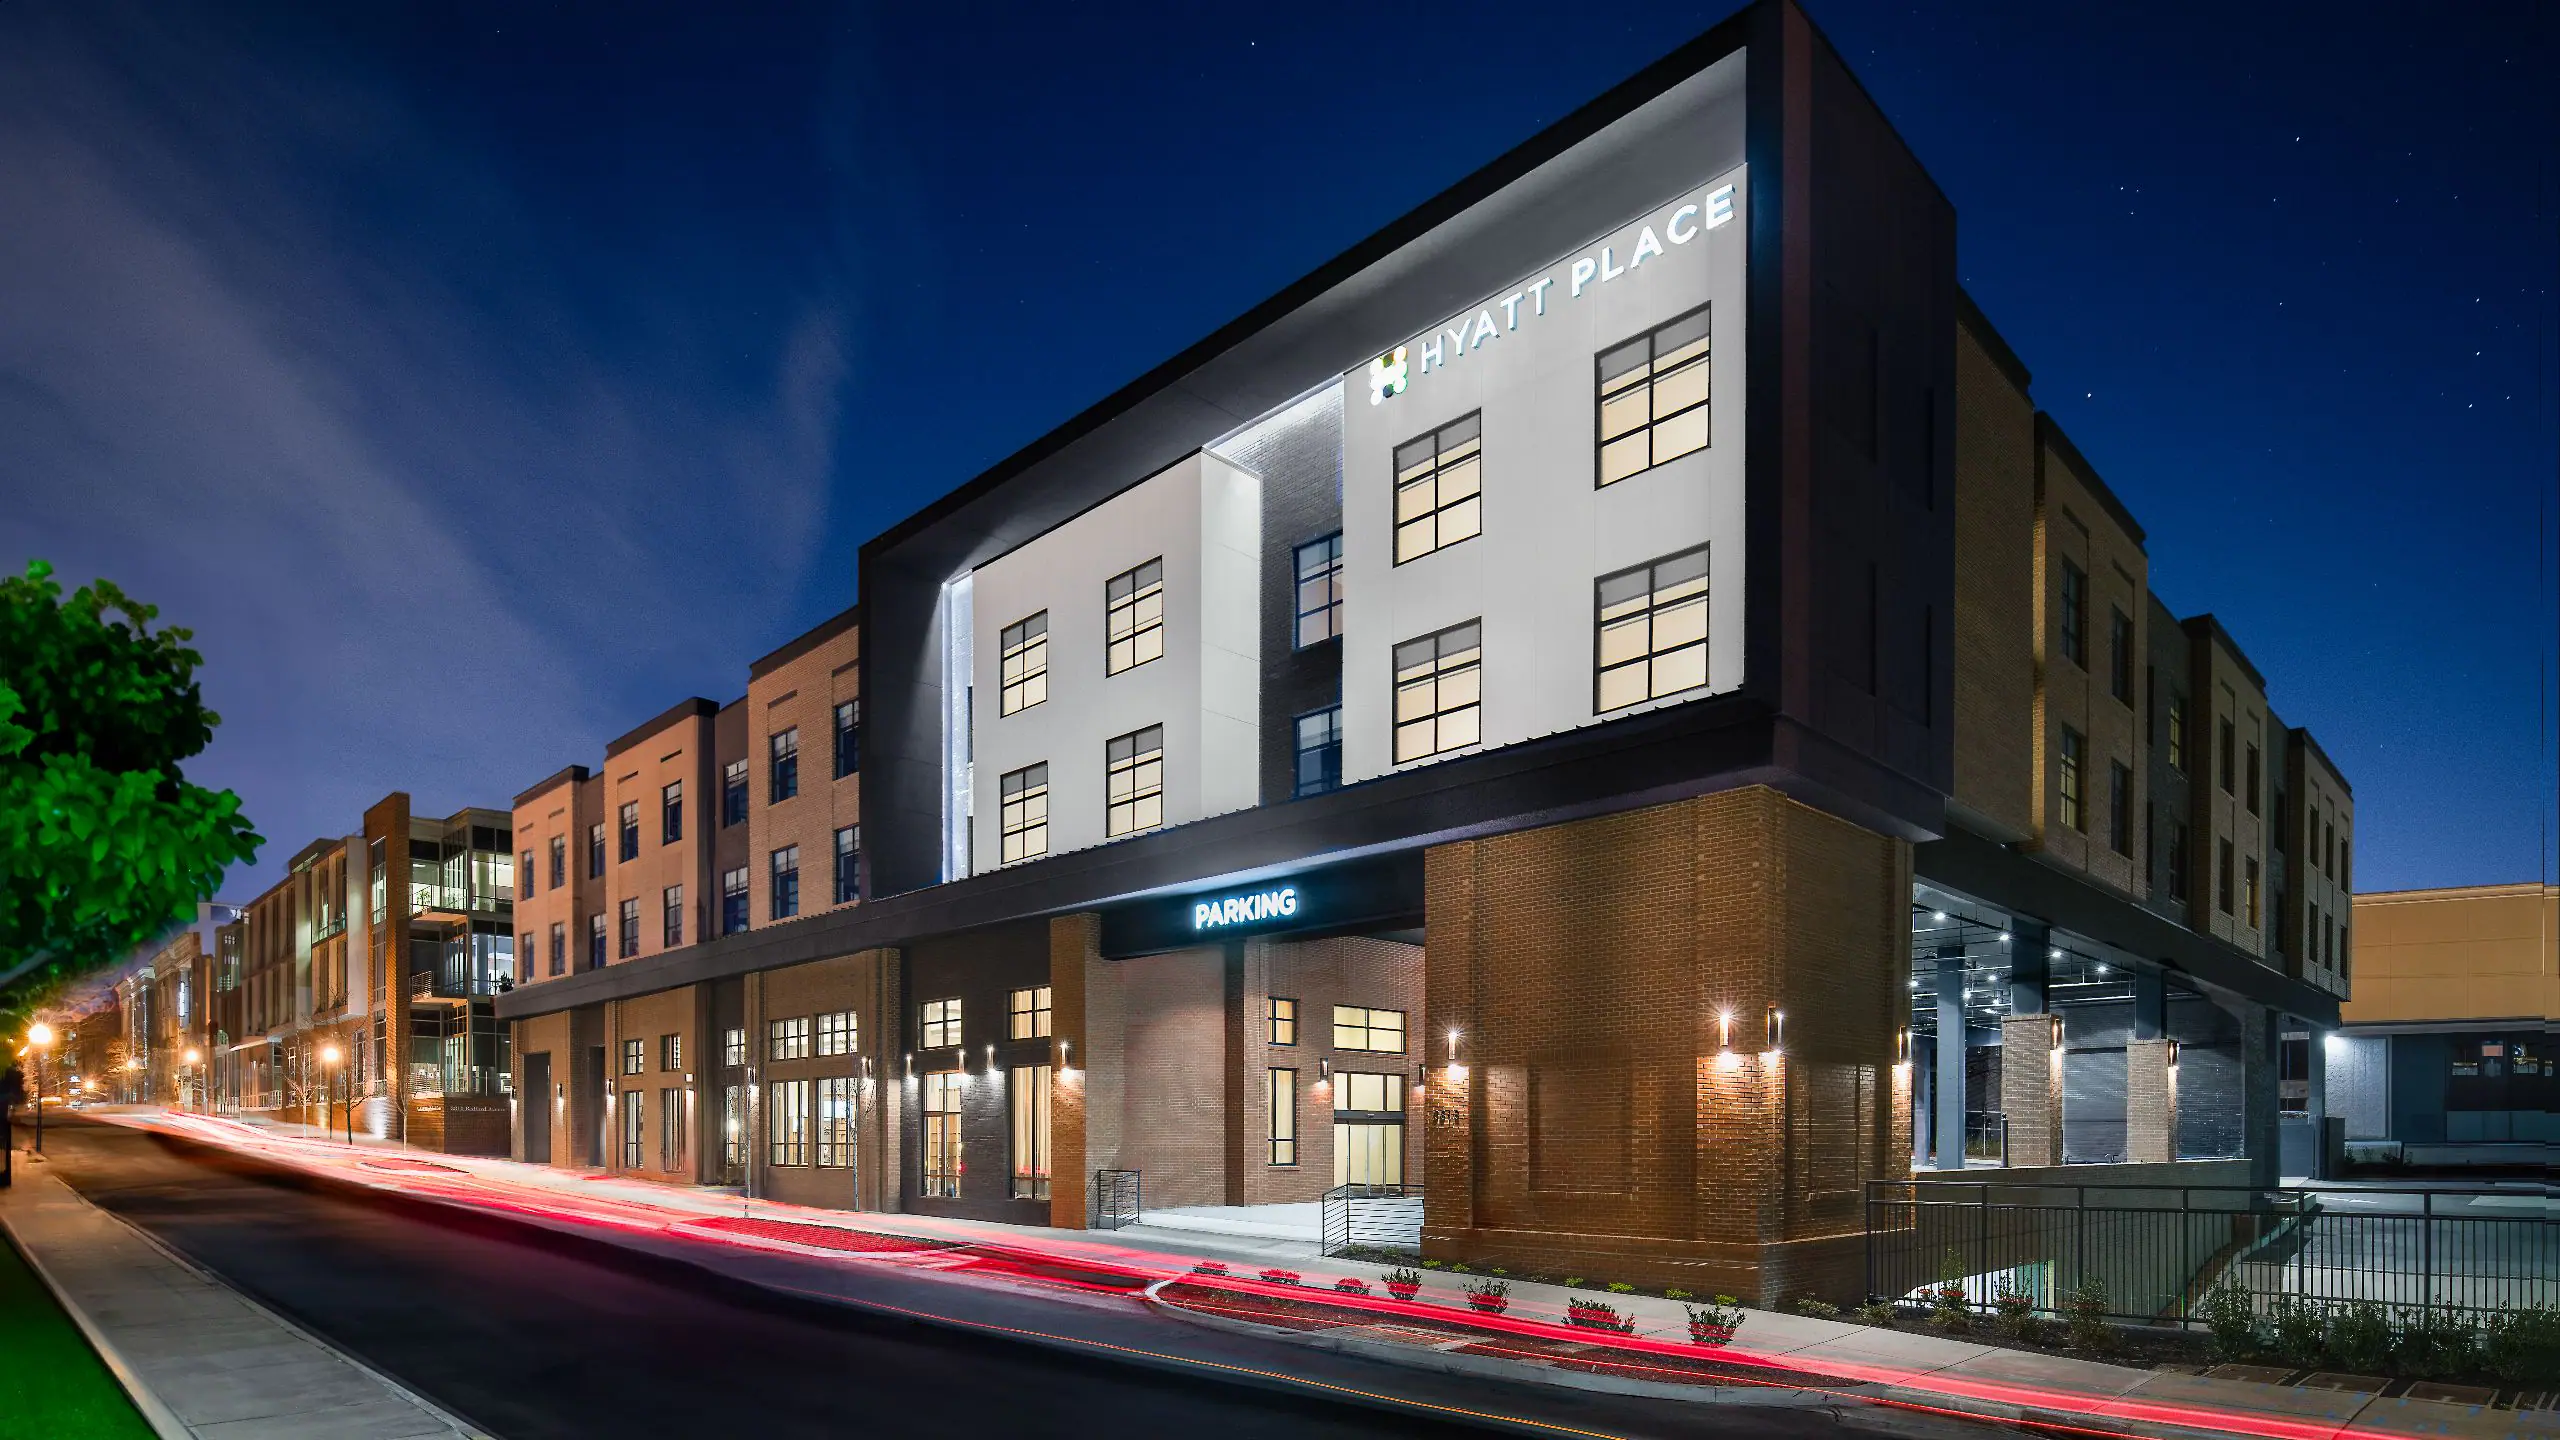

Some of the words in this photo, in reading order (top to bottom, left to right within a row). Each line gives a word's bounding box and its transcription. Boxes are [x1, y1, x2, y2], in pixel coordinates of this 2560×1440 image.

[1420, 276, 1554, 374] HYATT
[1571, 183, 1736, 298] PLACE
[1195, 888, 1297, 930] PARKING
